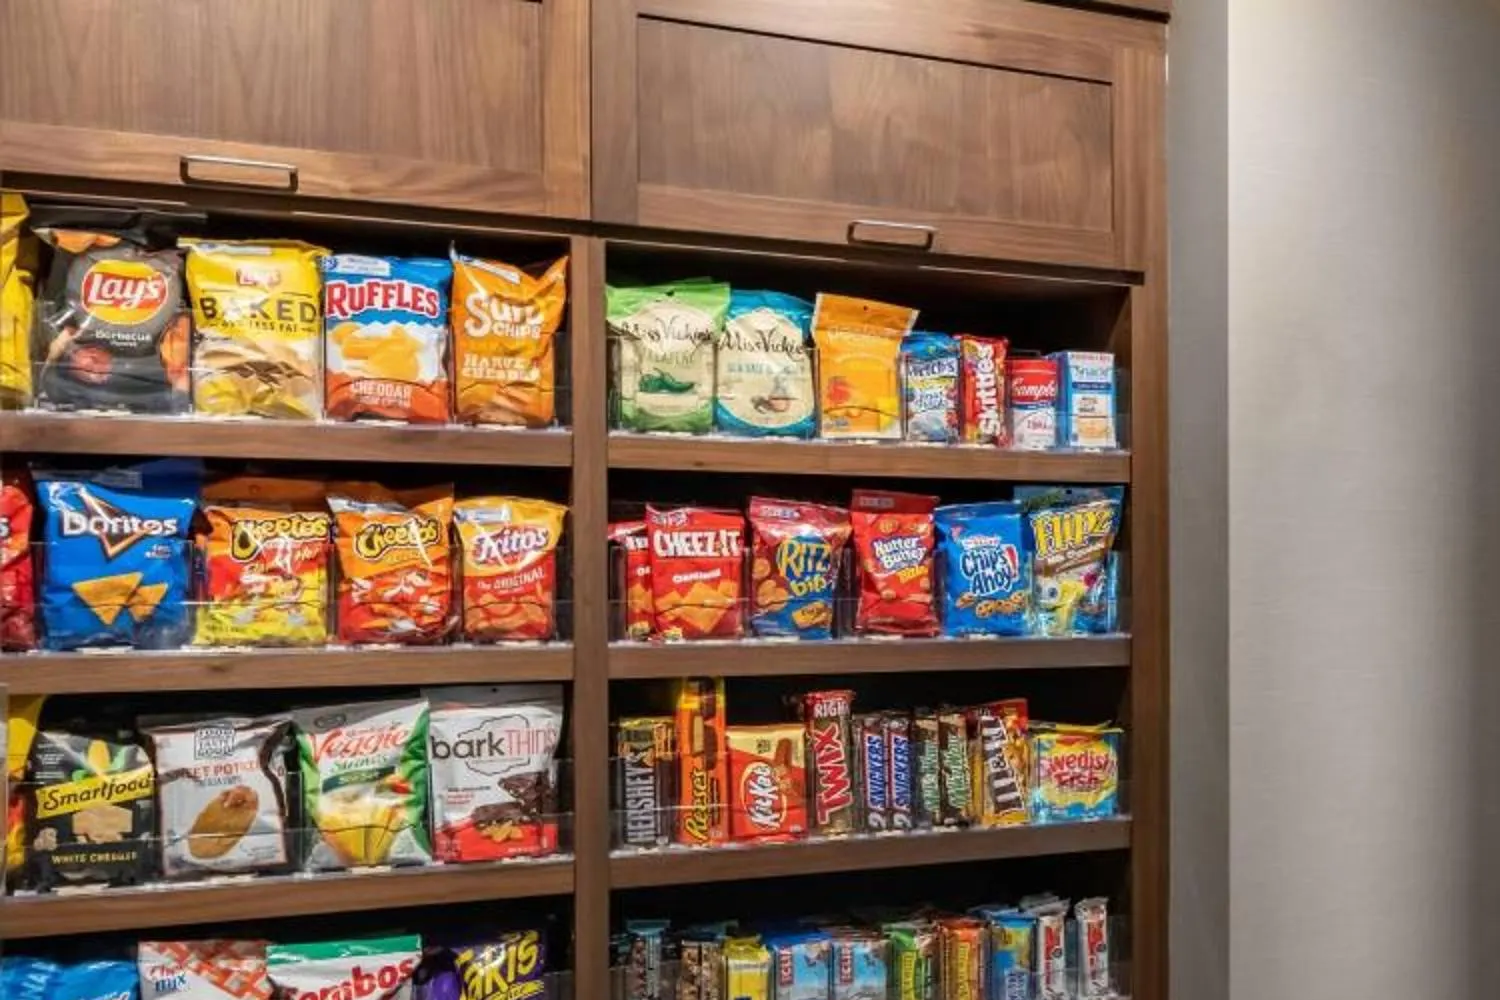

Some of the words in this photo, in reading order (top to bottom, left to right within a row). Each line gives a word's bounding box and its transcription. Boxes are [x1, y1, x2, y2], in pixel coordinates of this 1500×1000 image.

[90, 272, 163, 308] Lay's
[326, 281, 440, 318] RUFFLES
[62, 510, 178, 536] Doritos
[779, 539, 832, 575] RITZ
[961, 549, 1007, 577] Chips
[493, 567, 545, 589] ORIGINAL
[307, 721, 409, 763] Veggie
[431, 731, 506, 760] bark
[814, 723, 852, 824] TWIX
[866, 735, 886, 812] SNICKERS
[892, 735, 912, 812] SNICKERS
[1039, 750, 1114, 777] Swedish
[1054, 771, 1102, 789] Fish
[42, 770, 154, 811] Smartfood
[625, 751, 656, 844] HERSHEY'S
